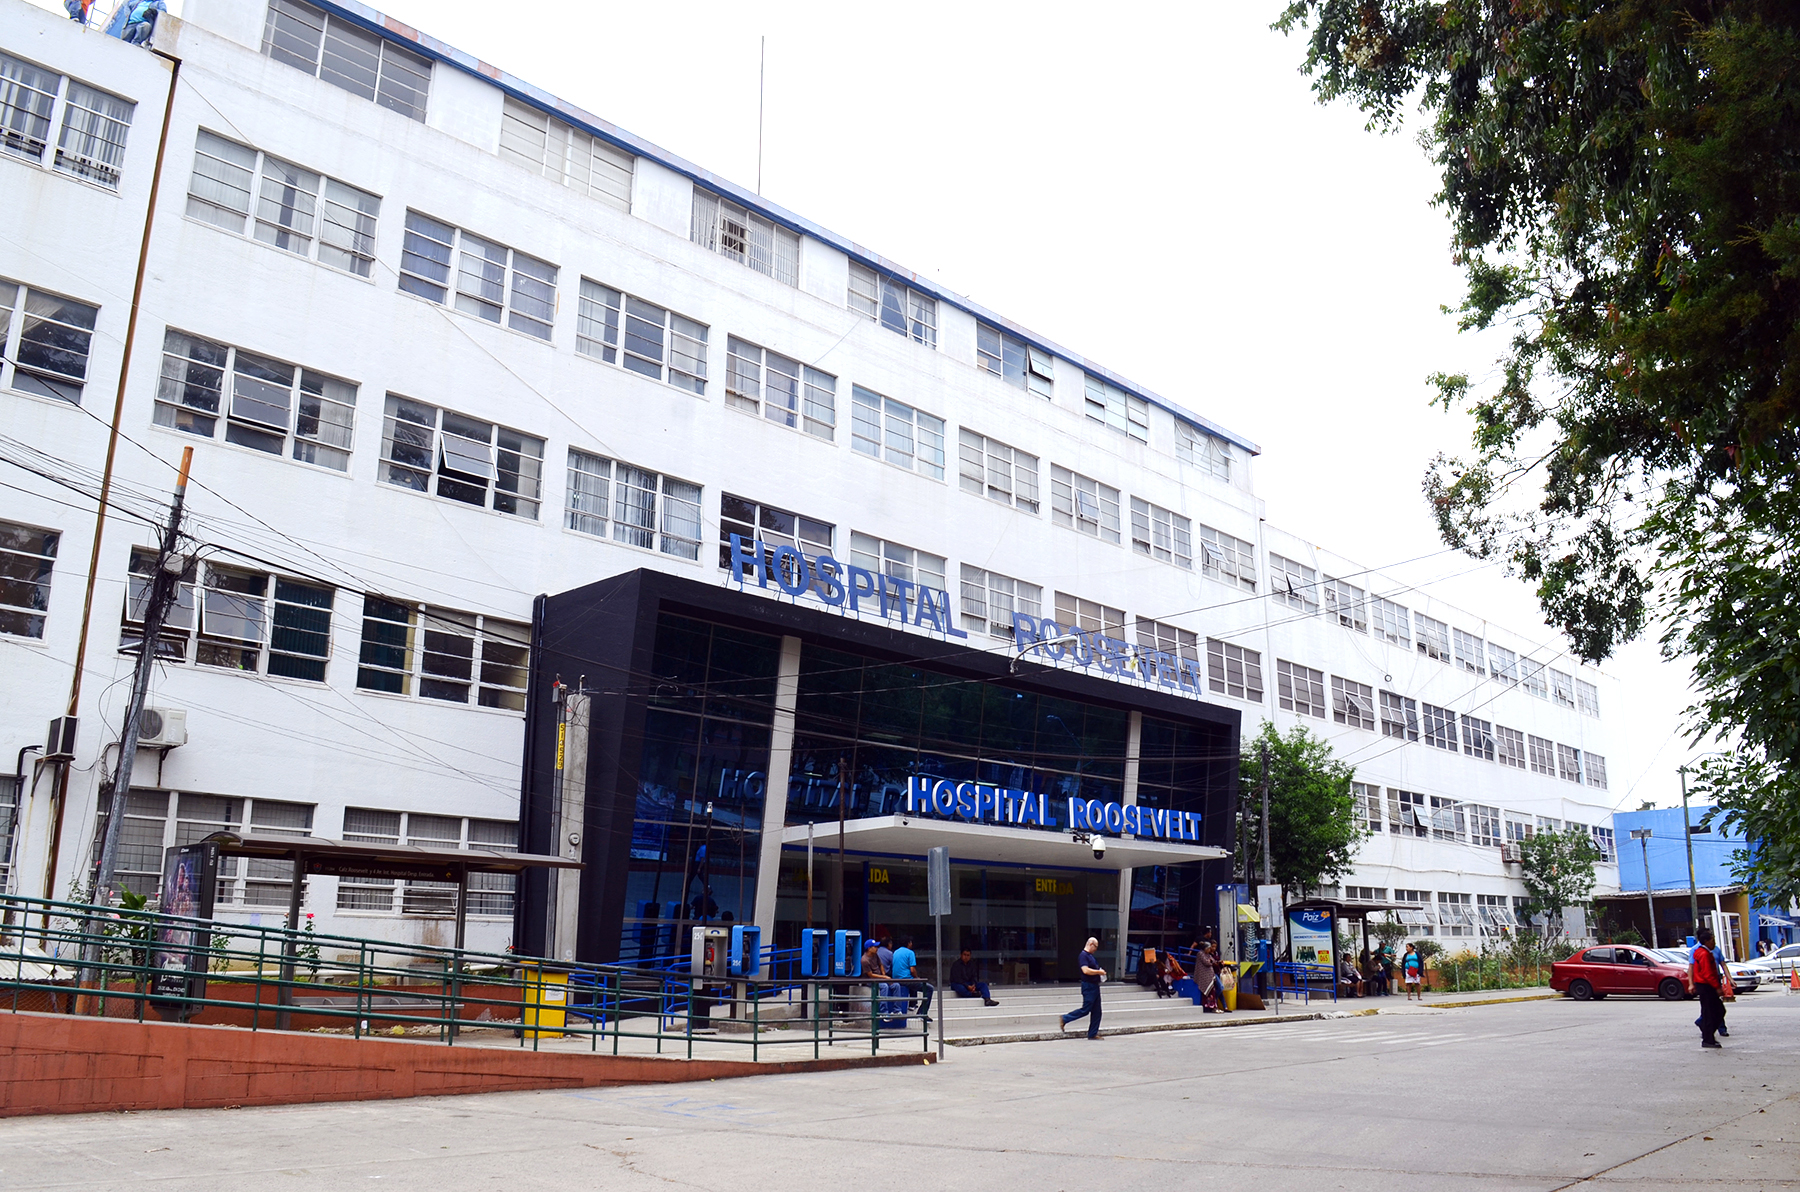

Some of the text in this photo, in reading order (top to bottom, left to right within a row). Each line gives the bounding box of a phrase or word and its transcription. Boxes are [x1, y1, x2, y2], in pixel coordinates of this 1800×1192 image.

[730, 533, 1201, 695] HOSPITAL ROOSEVELT
[718, 768, 868, 810] HOPITAL
[907, 776, 1057, 826] HOSPITAL
[1069, 796, 1202, 841] ROOSEVELT
[1302, 912, 1320, 921] Paiz
